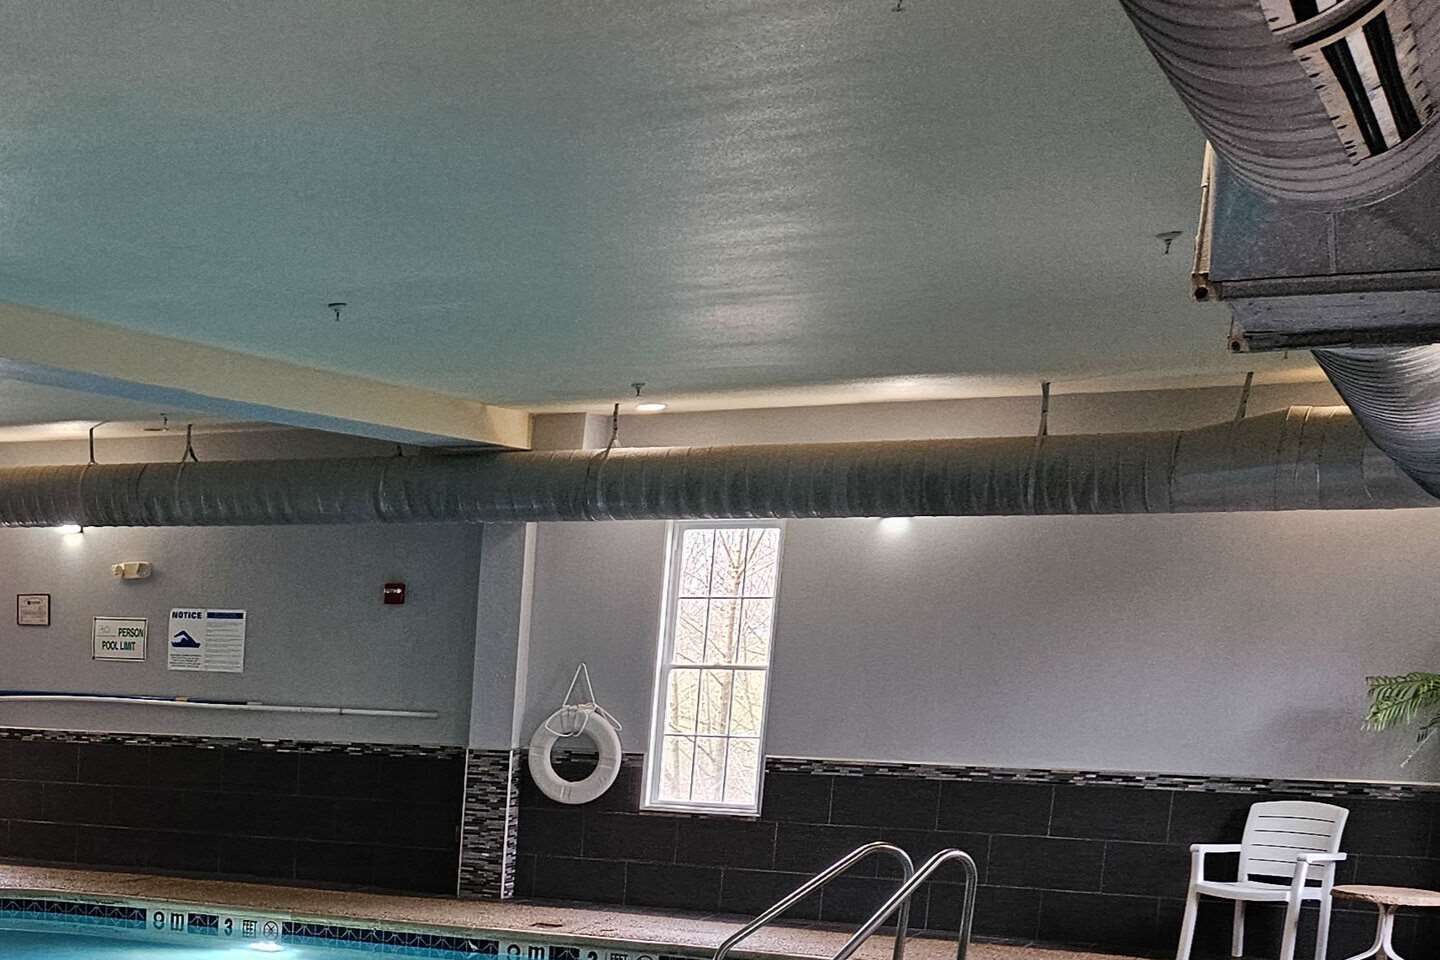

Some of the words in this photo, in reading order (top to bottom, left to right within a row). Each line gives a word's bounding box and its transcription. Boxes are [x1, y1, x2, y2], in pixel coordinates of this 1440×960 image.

[172, 611, 202, 619] NOTICE
[118, 627, 144, 638] PERSON
[101, 640, 118, 650] POOL
[119, 641, 136, 651] LIMIT
